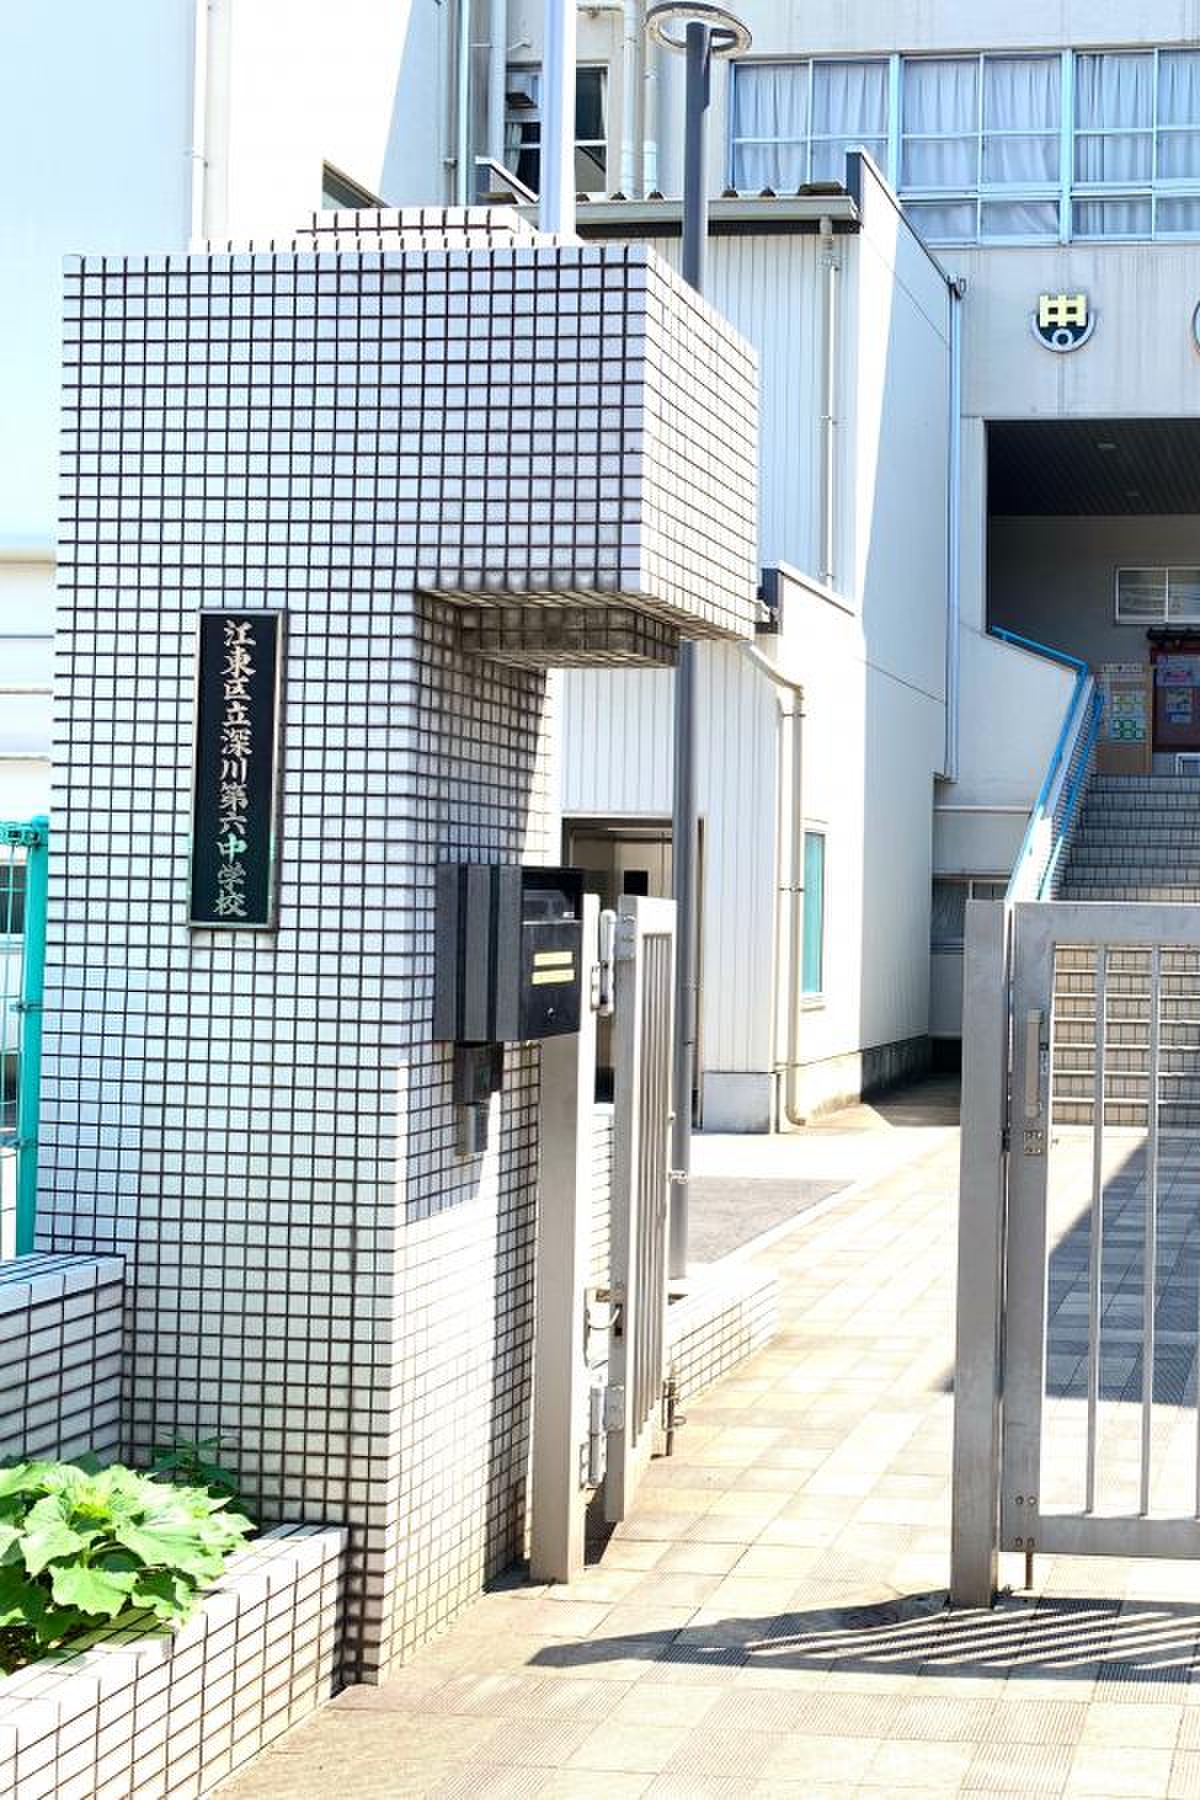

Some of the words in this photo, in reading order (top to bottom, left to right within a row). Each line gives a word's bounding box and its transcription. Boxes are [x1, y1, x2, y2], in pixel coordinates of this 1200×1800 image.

[213, 619, 257, 917] 江東区立深川第六中学校
